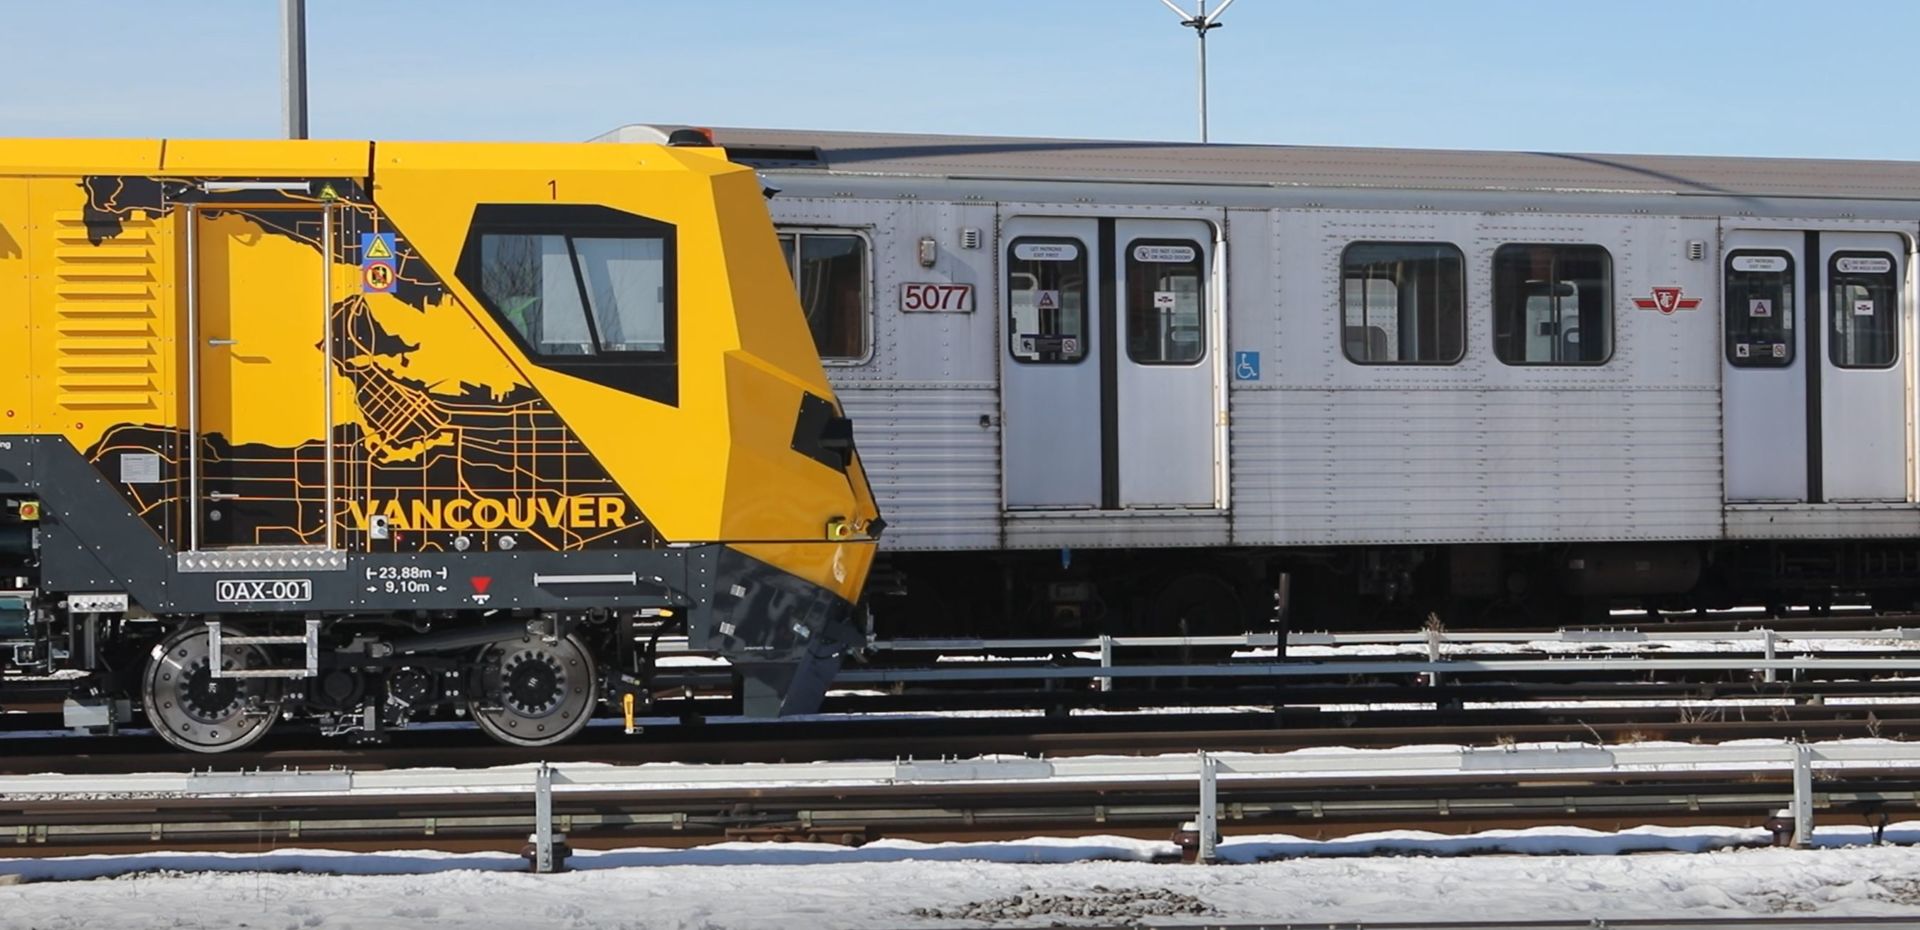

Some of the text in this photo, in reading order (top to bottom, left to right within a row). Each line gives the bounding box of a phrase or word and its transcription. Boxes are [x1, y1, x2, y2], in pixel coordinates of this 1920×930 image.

[547, 179, 557, 201] 1
[905, 284, 969, 310] 5077
[350, 497, 626, 530] VANCOUVER
[378, 566, 432, 580] 23,88m
[385, 580, 430, 594] 9,10m
